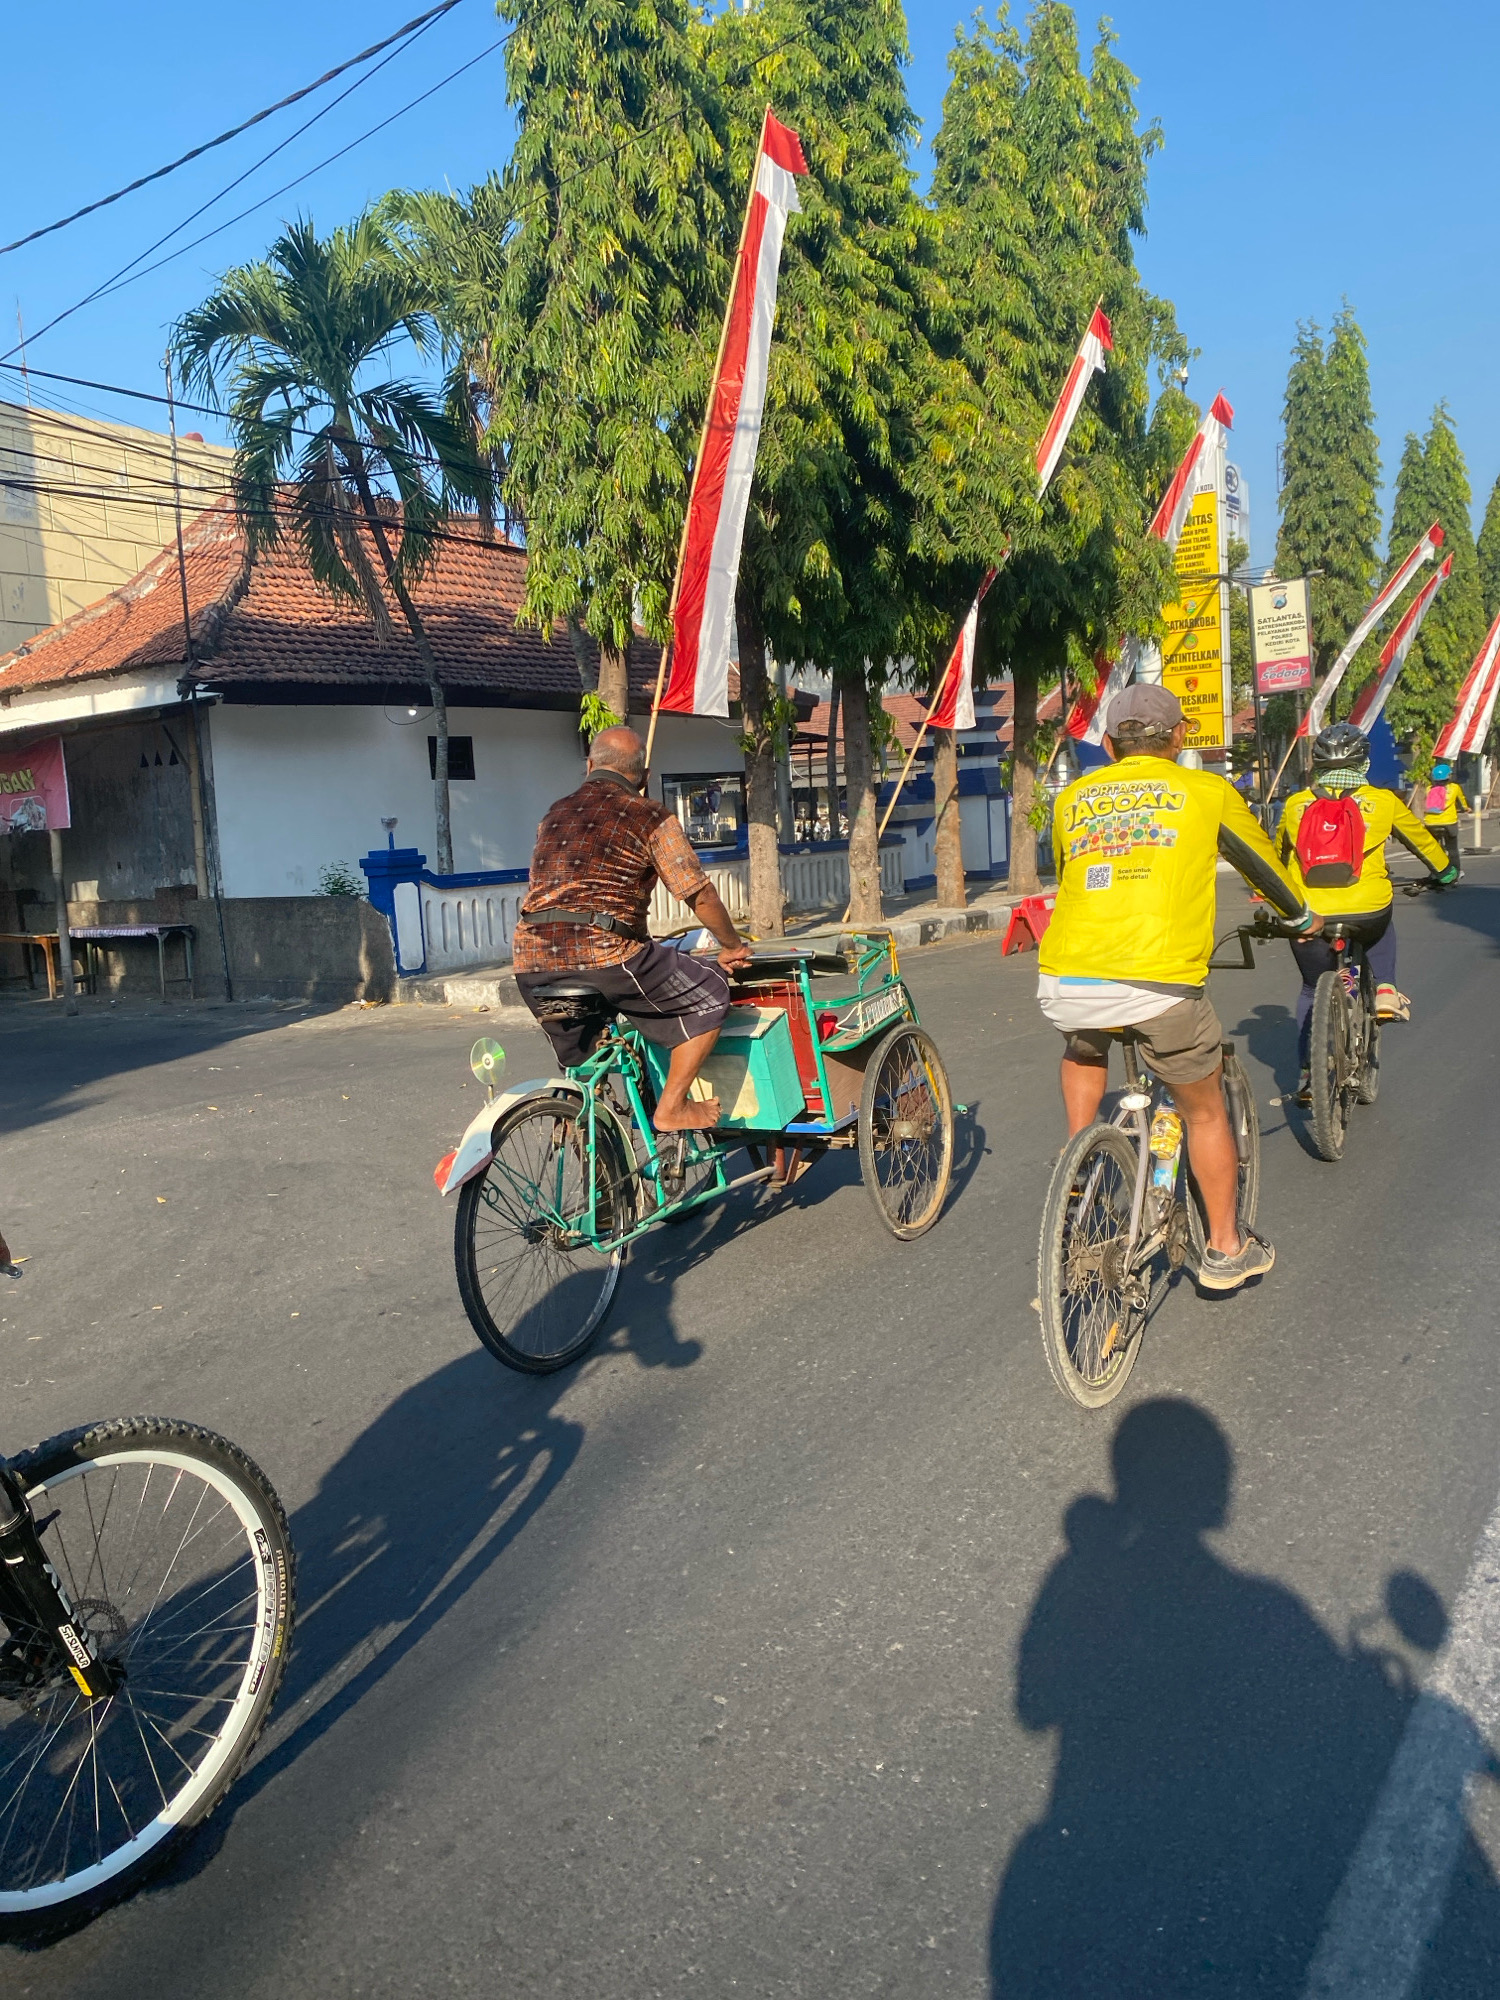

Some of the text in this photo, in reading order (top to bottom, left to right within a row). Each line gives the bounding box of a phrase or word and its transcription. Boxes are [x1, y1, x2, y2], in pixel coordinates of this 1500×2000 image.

[1257, 627, 1290, 637] PELAYANAN
[1271, 632, 1293, 641] POLRES
[1265, 640, 1284, 648] KEDIRI
[1163, 650, 1219, 665] SATINTELKAM
[1177, 693, 1218, 706] RESKRIM
[1184, 735, 1220, 746] MKOPPOL
[0, 768, 36, 794] GAN
[1077, 783, 1168, 799] MORTARNYA
[1064, 792, 1184, 831] JAGOAN
[276, 1549, 287, 1619] FIREROLLER
[260, 1563, 276, 1662] UNITED
[67, 1637, 89, 1667] SUNTOUR
